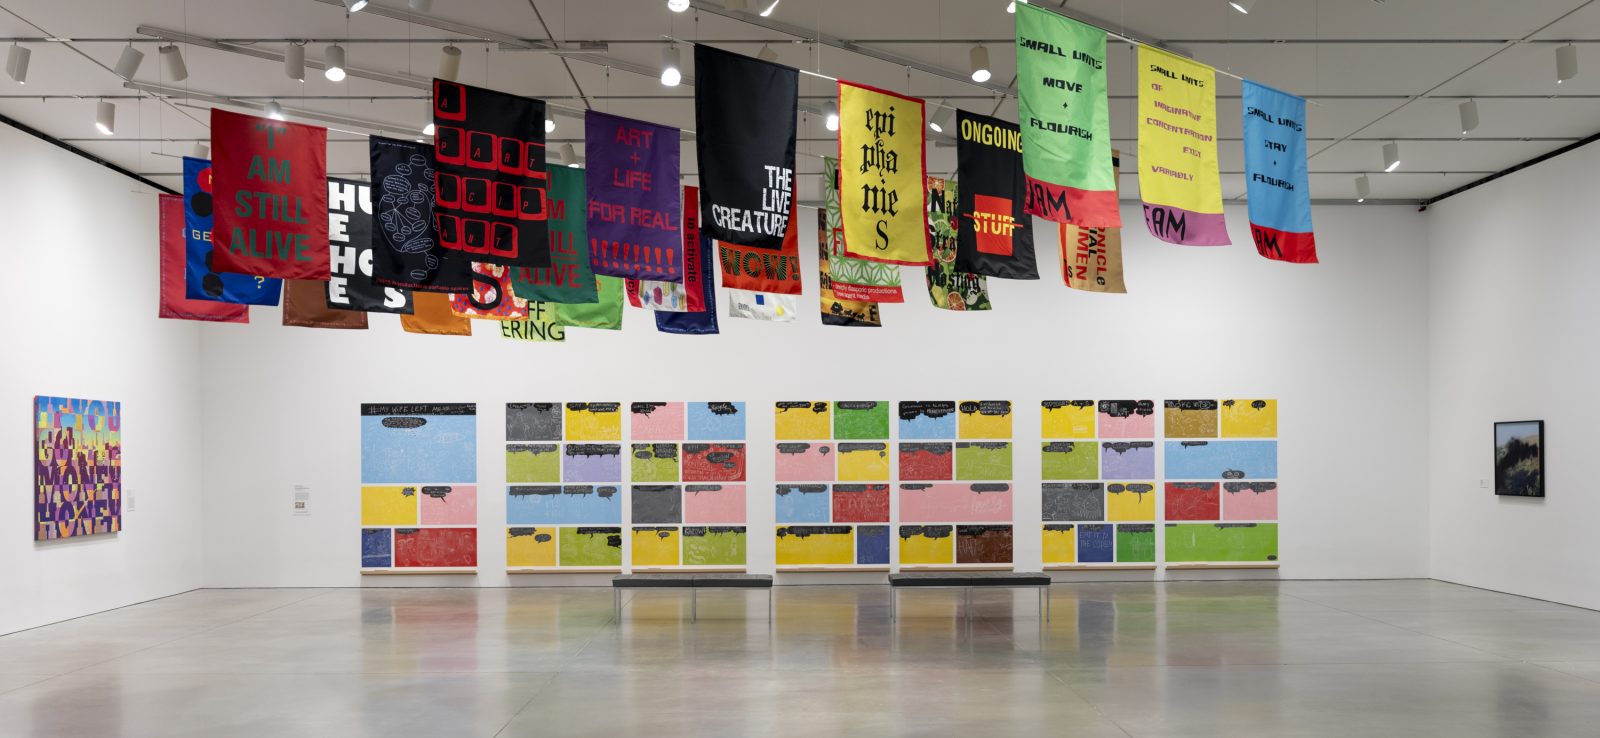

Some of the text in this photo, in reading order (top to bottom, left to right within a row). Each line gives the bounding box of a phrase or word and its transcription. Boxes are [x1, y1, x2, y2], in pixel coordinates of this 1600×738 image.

[1020, 36, 1066, 57] SMALL
[1043, 76, 1083, 94] MOVE
[1151, 83, 1163, 92] OF
[615, 124, 654, 149] ART
[865, 105, 896, 139] epi
[1031, 117, 1093, 141] FLOURISH
[247, 155, 291, 185] AM
[860, 138, 899, 177] pha
[613, 167, 652, 192] LIFE
[764, 165, 793, 192] THE
[235, 190, 310, 225] STILL
[762, 188, 791, 215] LIVE
[861, 178, 899, 217] nie
[589, 201, 678, 231] FOR REAL
[712, 204, 789, 238] CREATURE
[973, 211, 1015, 237] STUFF
[229, 227, 314, 262] ALIVE
[876, 220, 889, 251] S
[720, 246, 800, 282] WOW!
